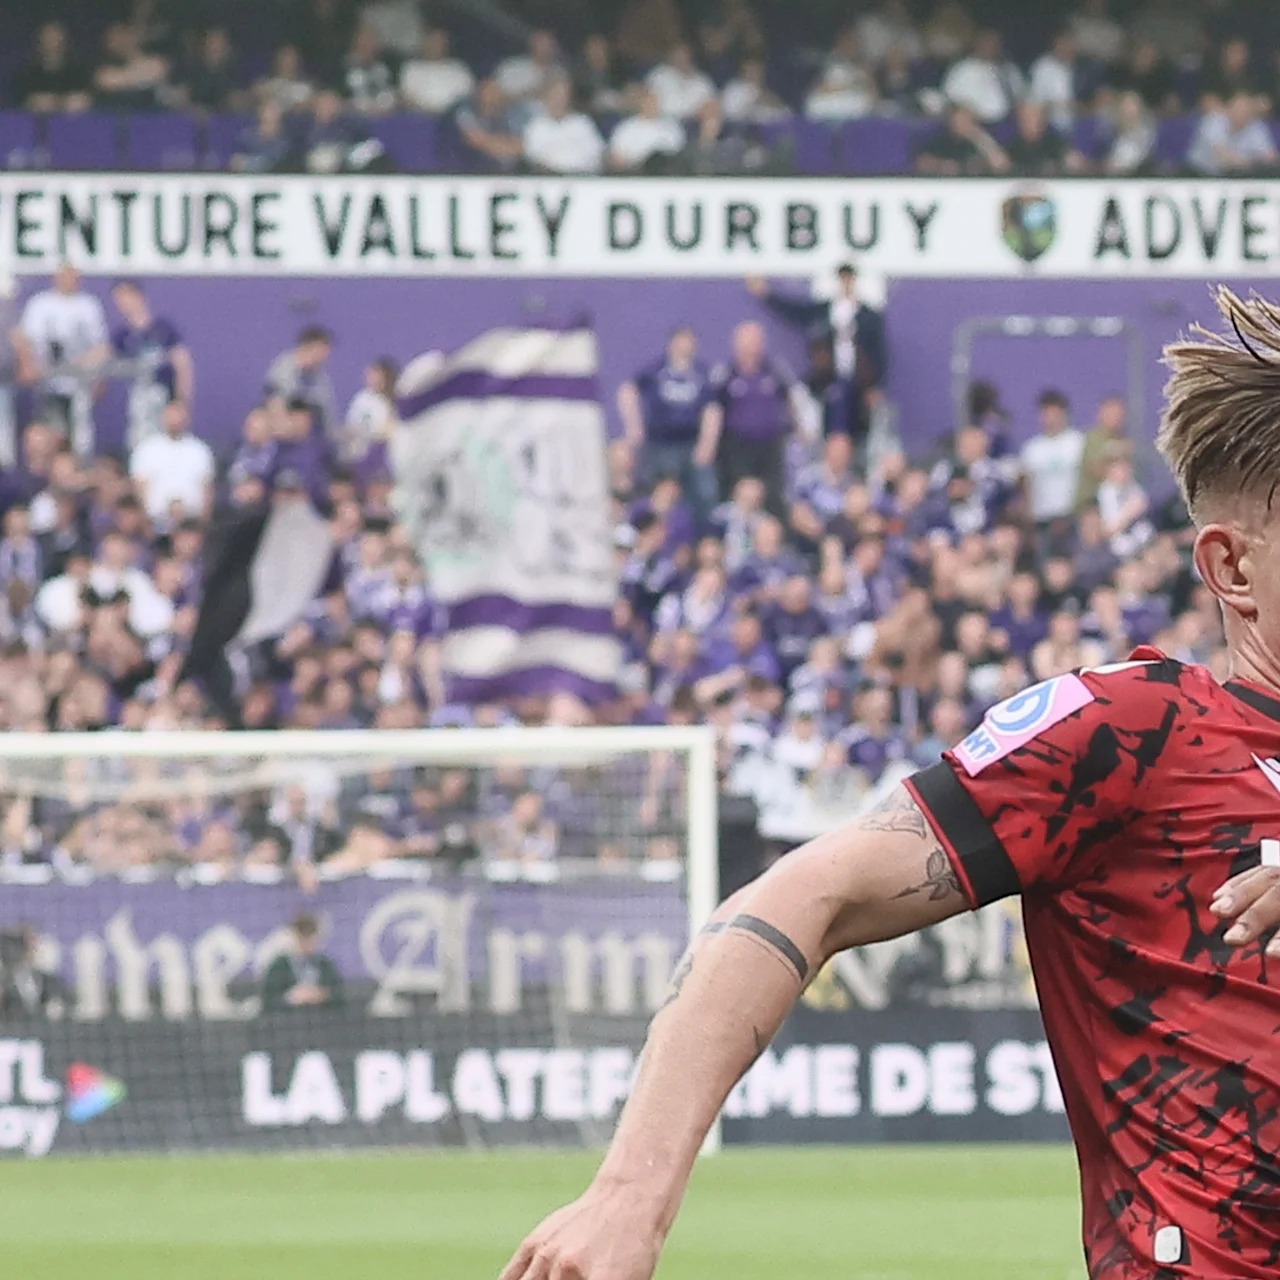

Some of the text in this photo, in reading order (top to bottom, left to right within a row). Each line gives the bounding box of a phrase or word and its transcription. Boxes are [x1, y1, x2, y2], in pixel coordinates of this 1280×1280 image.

[14, 190, 940, 260] ENTURE VALLEY DURBUY
[242, 1050, 347, 1125] LA
[868, 1041, 977, 1117] DE
